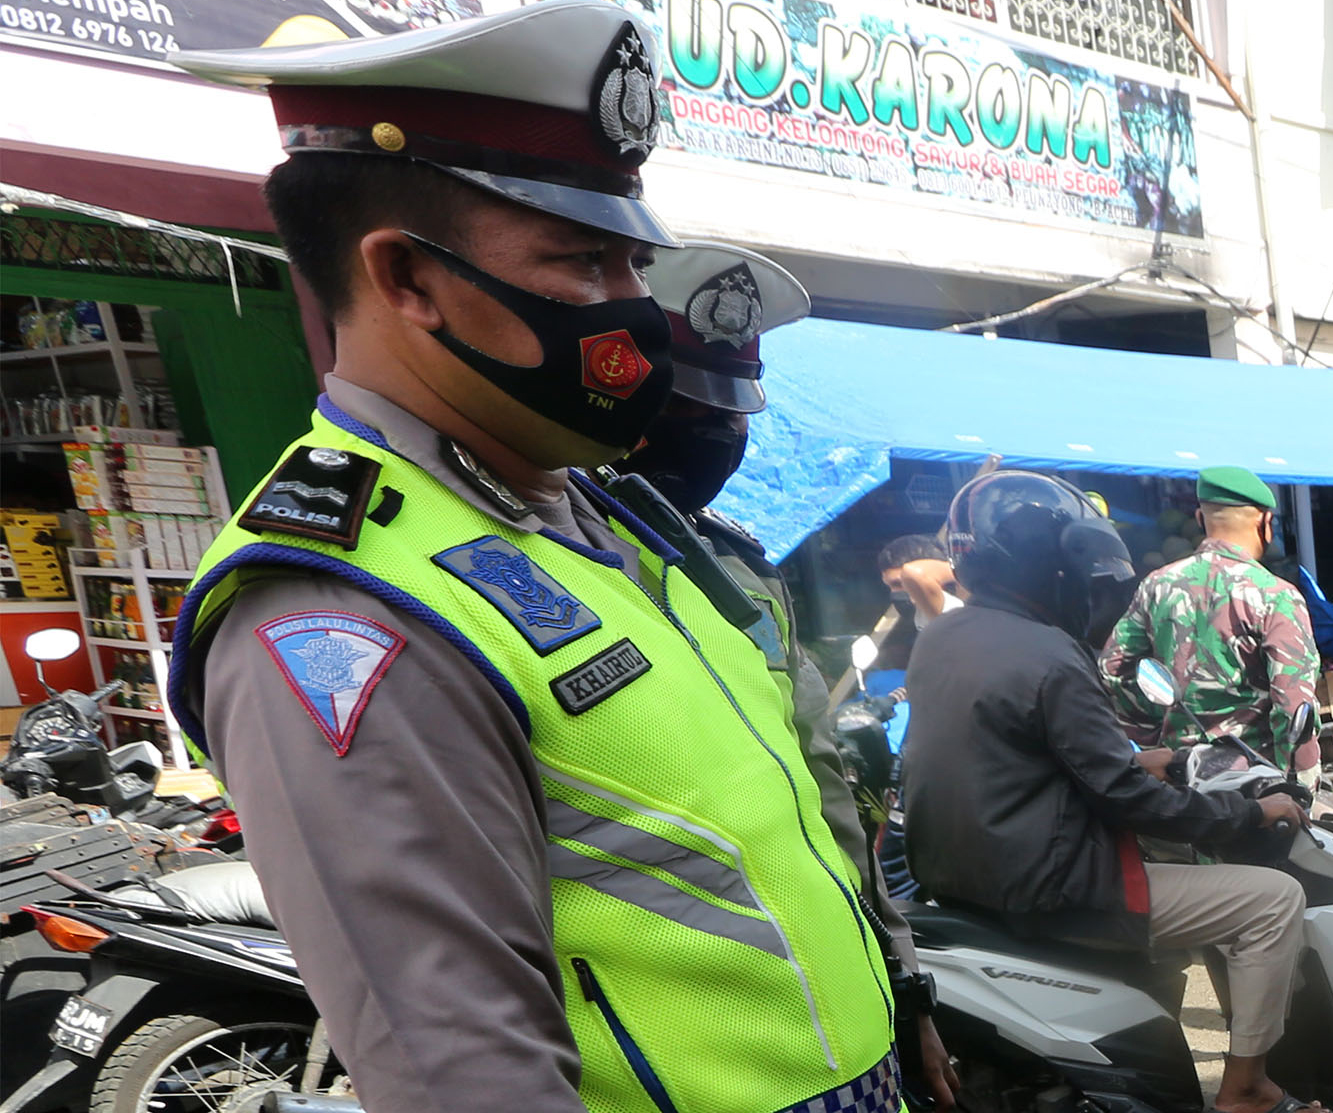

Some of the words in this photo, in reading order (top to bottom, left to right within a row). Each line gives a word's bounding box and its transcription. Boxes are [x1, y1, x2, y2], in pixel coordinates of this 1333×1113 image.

[1, 5, 66, 36] 0812
[72, 17, 134, 48] 6976
[673, 94, 769, 134] DAGANG
[916, 142, 981, 174] SAYUR
[989, 157, 1005, 177] &
[1011, 161, 1058, 187] BUAH
[1064, 170, 1120, 198] SEGAR
[587, 392, 615, 411] TNI
[255, 502, 341, 527] POLISI
[267, 620, 306, 639] POLISI
[308, 616, 342, 630] LALU
[344, 619, 393, 647] LINTAS
[564, 647, 643, 702] KHAIRUL
